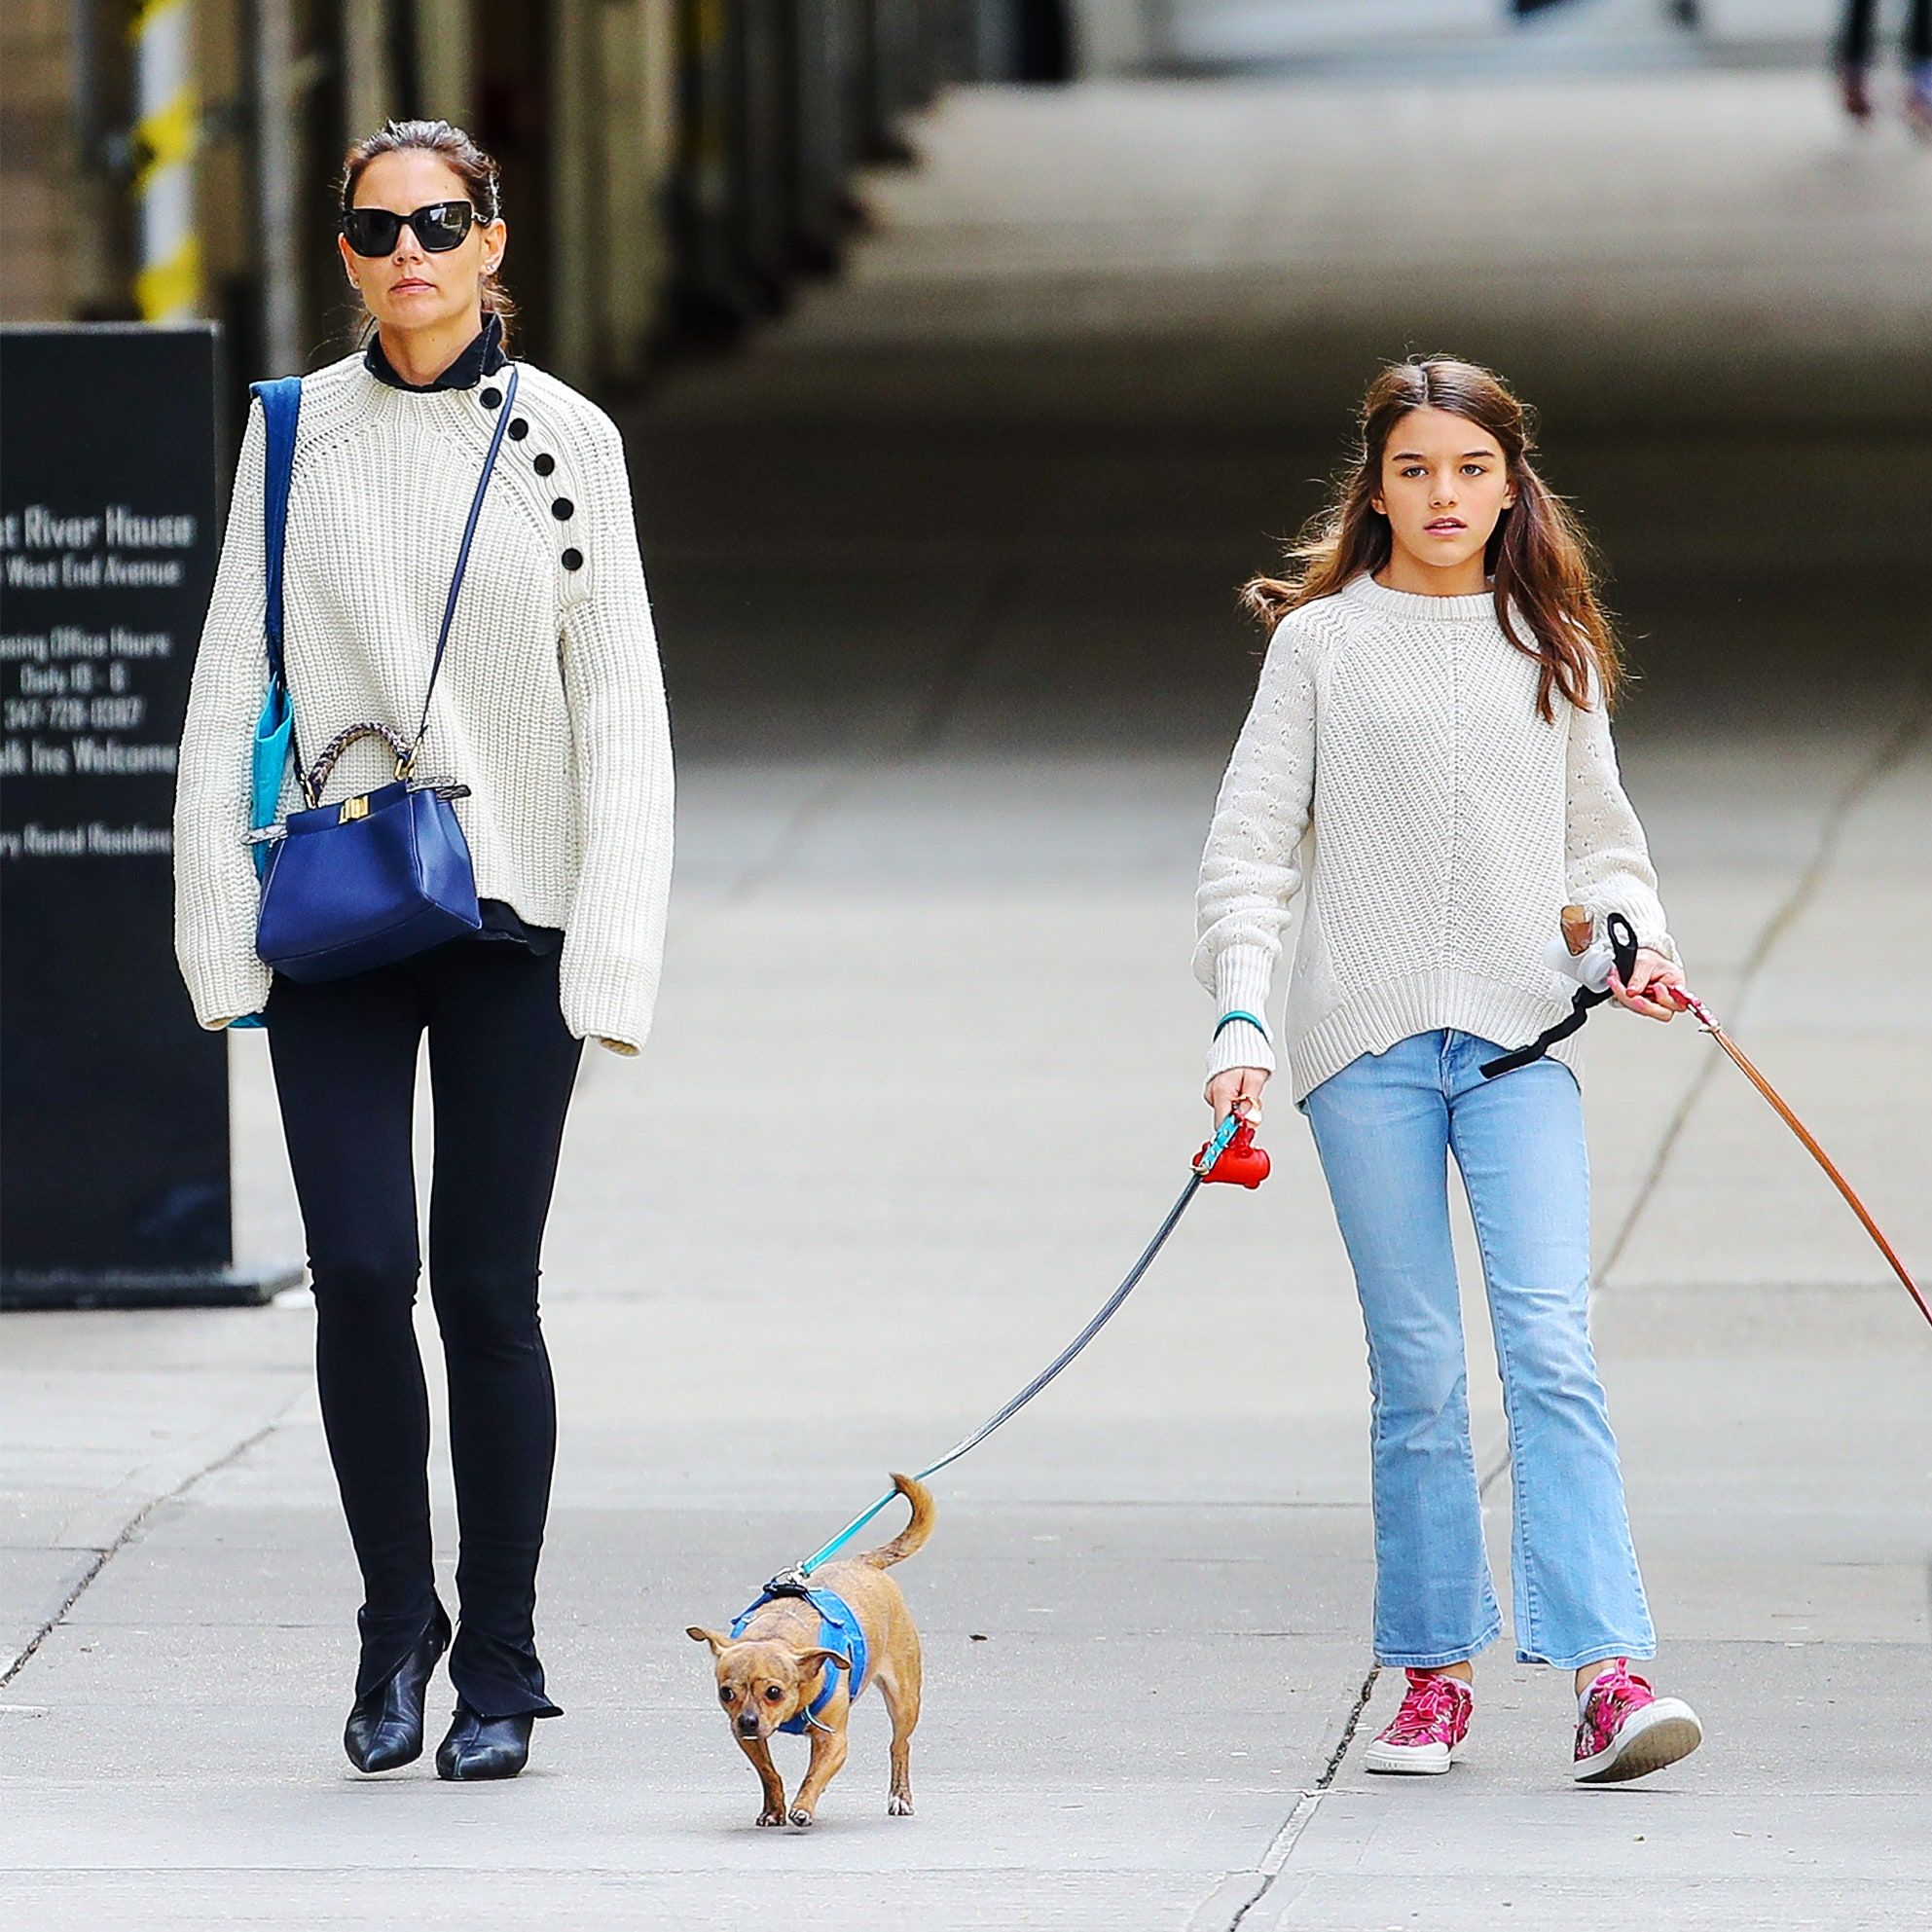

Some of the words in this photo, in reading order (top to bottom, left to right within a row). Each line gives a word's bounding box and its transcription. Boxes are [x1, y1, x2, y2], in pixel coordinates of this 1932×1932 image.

[24, 504, 98, 548] River
[105, 504, 194, 548] House
[8, 554, 58, 587] West
[62, 553, 100, 586] End
[104, 553, 182, 586] Avenue
[110, 626, 170, 658] Hours
